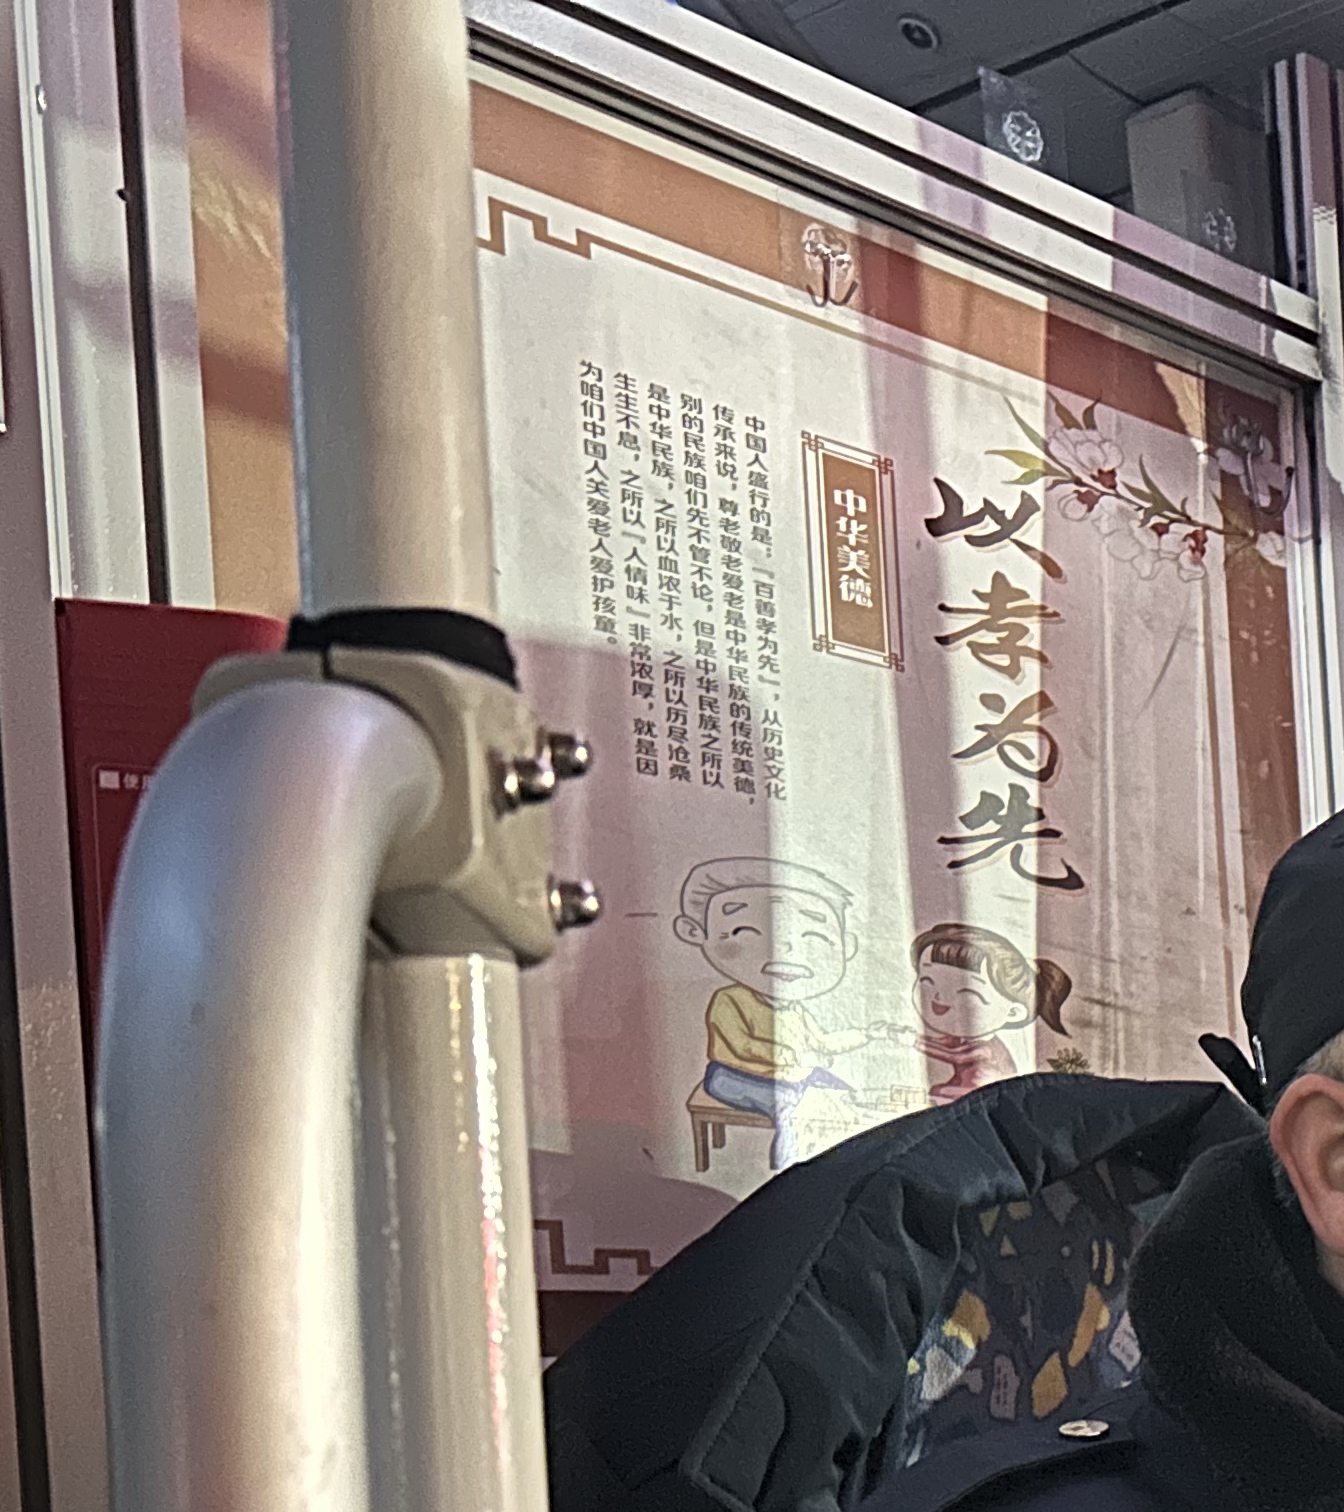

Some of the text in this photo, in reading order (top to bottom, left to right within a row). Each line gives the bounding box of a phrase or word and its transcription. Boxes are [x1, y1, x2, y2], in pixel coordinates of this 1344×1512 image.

[833, 488, 873, 609] 中华美德
[924, 477, 1085, 891] 以孝为先
